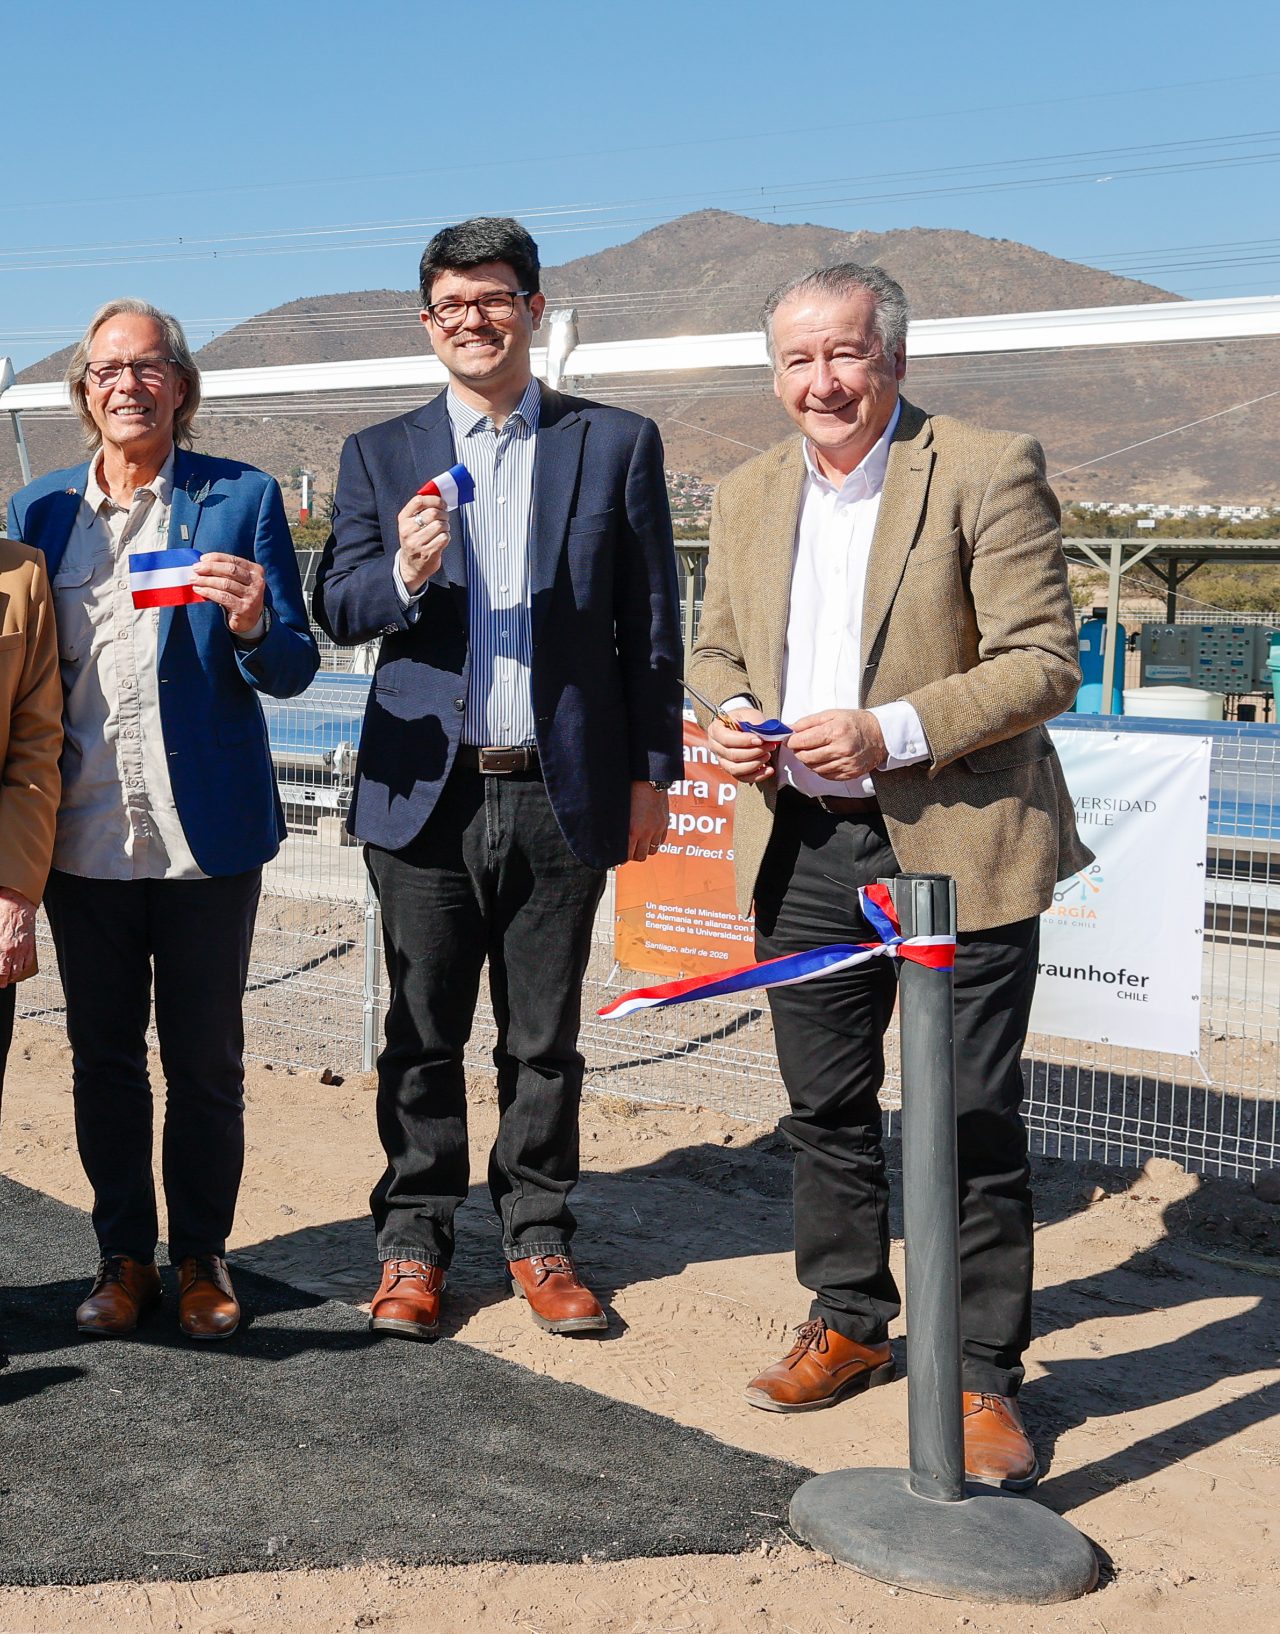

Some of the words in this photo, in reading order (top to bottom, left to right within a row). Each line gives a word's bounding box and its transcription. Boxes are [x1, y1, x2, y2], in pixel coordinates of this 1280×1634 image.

[683, 745, 719, 765] ant
[667, 780, 709, 798] ara
[718, 783, 737, 806] p
[1072, 797, 1157, 812] VERSIDAD
[667, 812, 727, 836] apor
[1076, 811, 1114, 826] HILE
[658, 843, 683, 855] olar
[686, 845, 723, 859] Direct
[726, 849, 735, 861] S
[645, 902, 657, 910] Un
[658, 904, 683, 914] aporte
[684, 907, 697, 915] del
[698, 909, 736, 920] Ministerio
[1048, 905, 1097, 919] ERGÍA
[657, 913, 692, 924] Alemania
[705, 919, 732, 930] alianza
[733, 924, 749, 932] con
[675, 925, 685, 933] de
[687, 926, 694, 934] la
[695, 928, 741, 942] Universidad
[743, 935, 754, 943] de
[680, 946, 696, 955] abril
[698, 949, 708, 957] de
[709, 950, 729, 960] 2026
[1037, 963, 1150, 988] raunhofer
[1116, 990, 1149, 1002] CHILE
